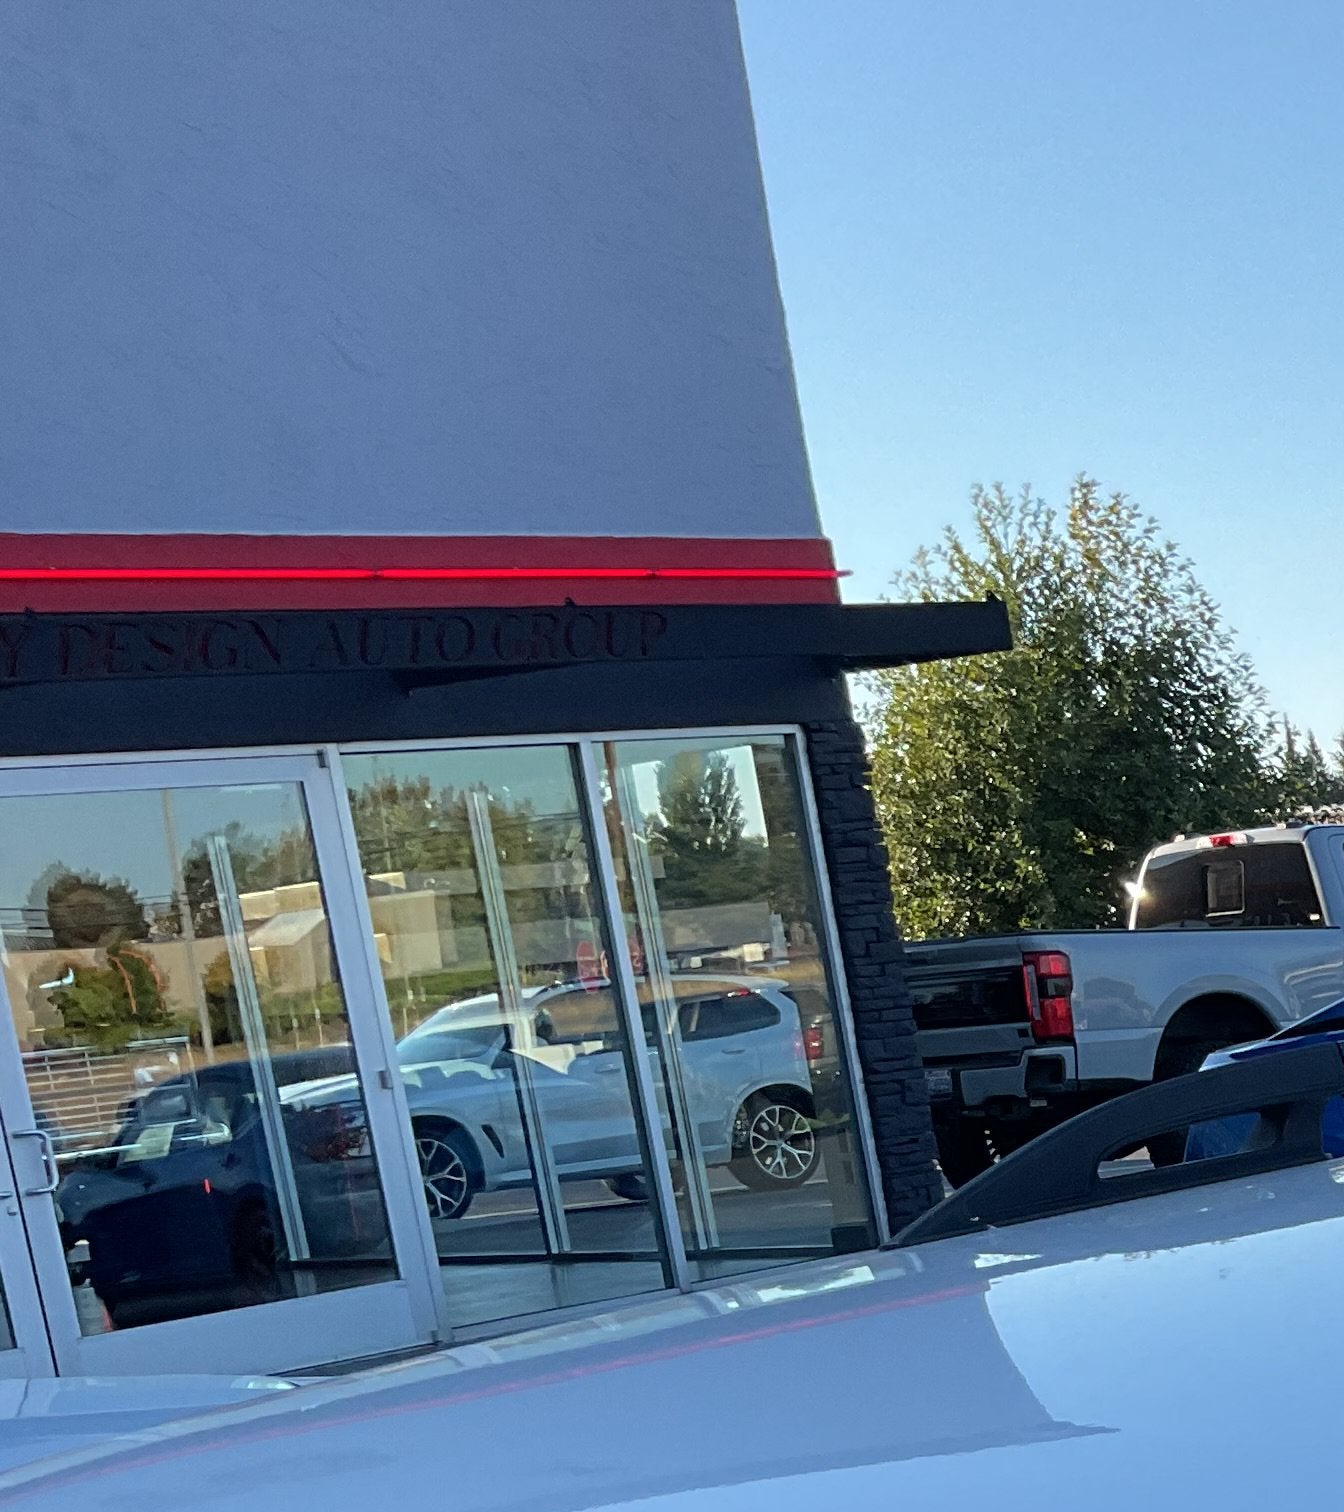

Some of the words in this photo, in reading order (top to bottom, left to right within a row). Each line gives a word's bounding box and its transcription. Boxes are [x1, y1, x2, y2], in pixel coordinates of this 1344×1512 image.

[57, 616, 286, 677] DESIGN
[309, 614, 476, 668] AUTO
[490, 609, 669, 663] GROUP
